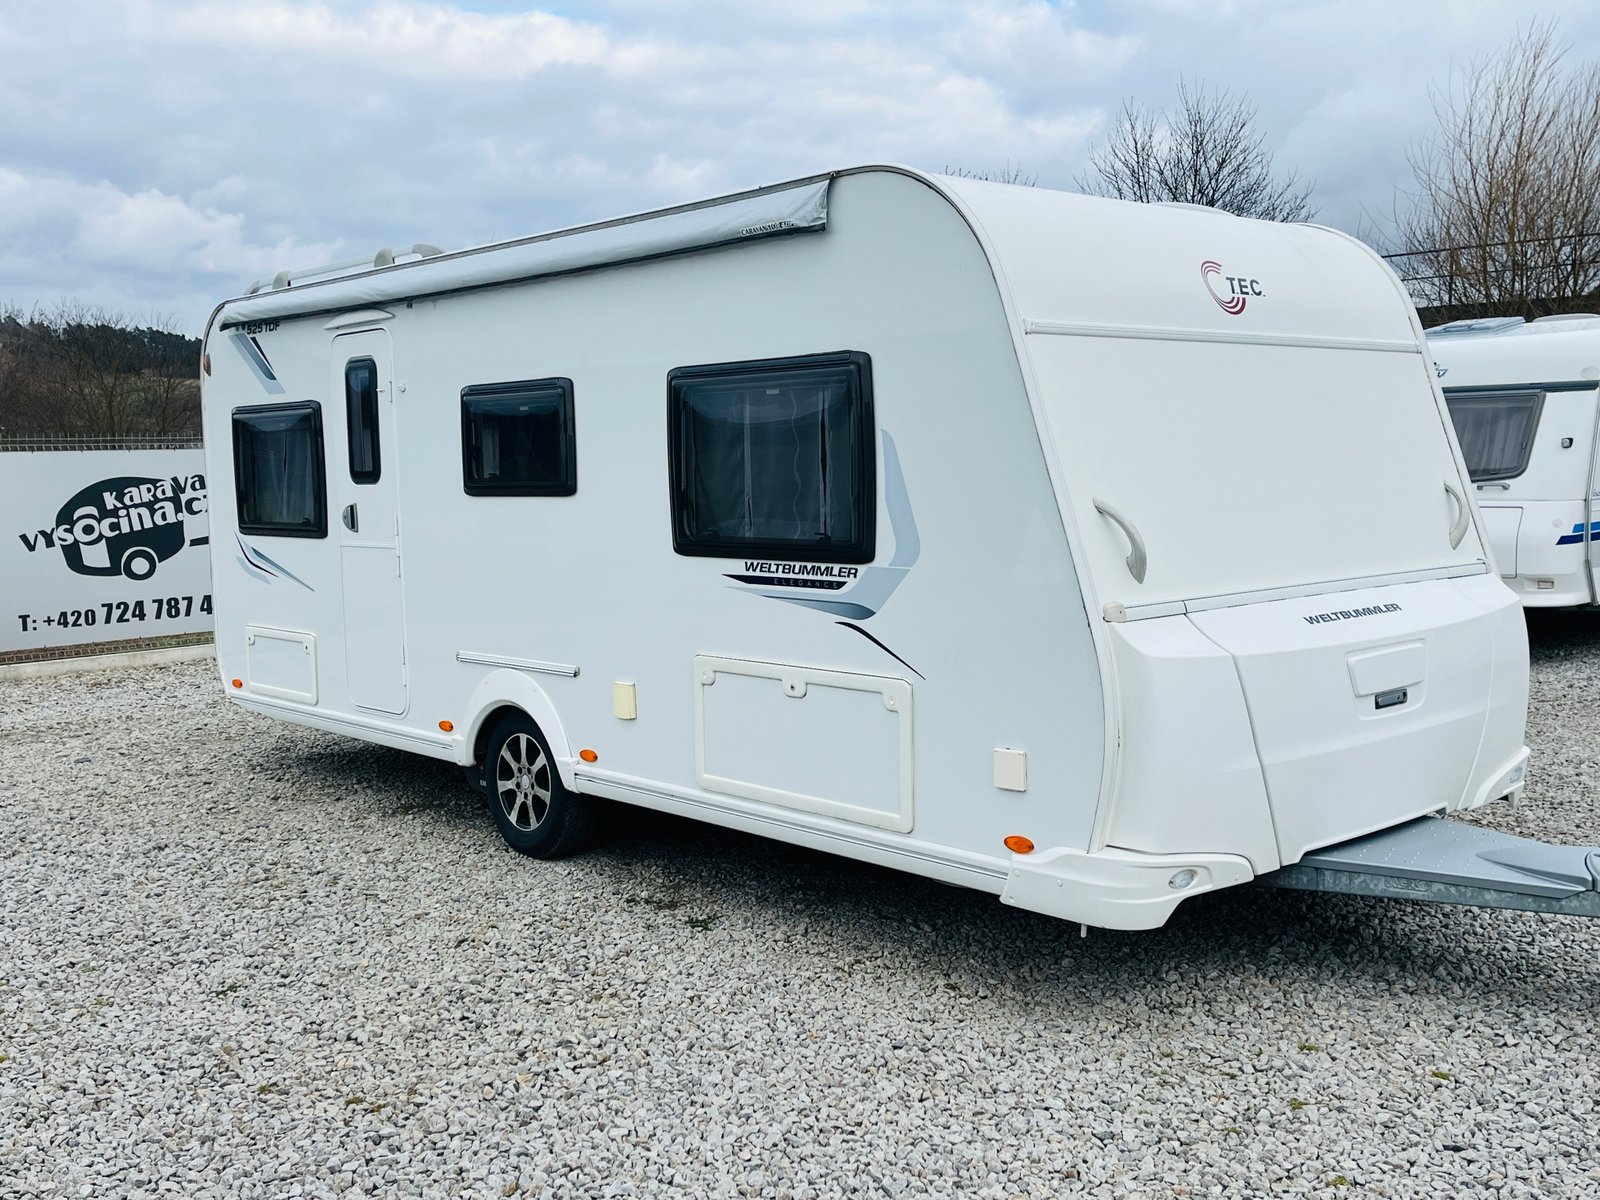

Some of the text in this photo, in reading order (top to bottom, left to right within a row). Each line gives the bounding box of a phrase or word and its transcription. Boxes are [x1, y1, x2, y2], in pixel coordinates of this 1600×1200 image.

[1225, 276, 1266, 297] T.E.C.
[246, 320, 280, 335] 525 TDF
[744, 561, 859, 579] WELTBUMMLER
[774, 578, 839, 589] ELEGANCE
[18, 594, 213, 632] T: +420 724 787 4
[1303, 603, 1403, 625] WELTBUMMLER
